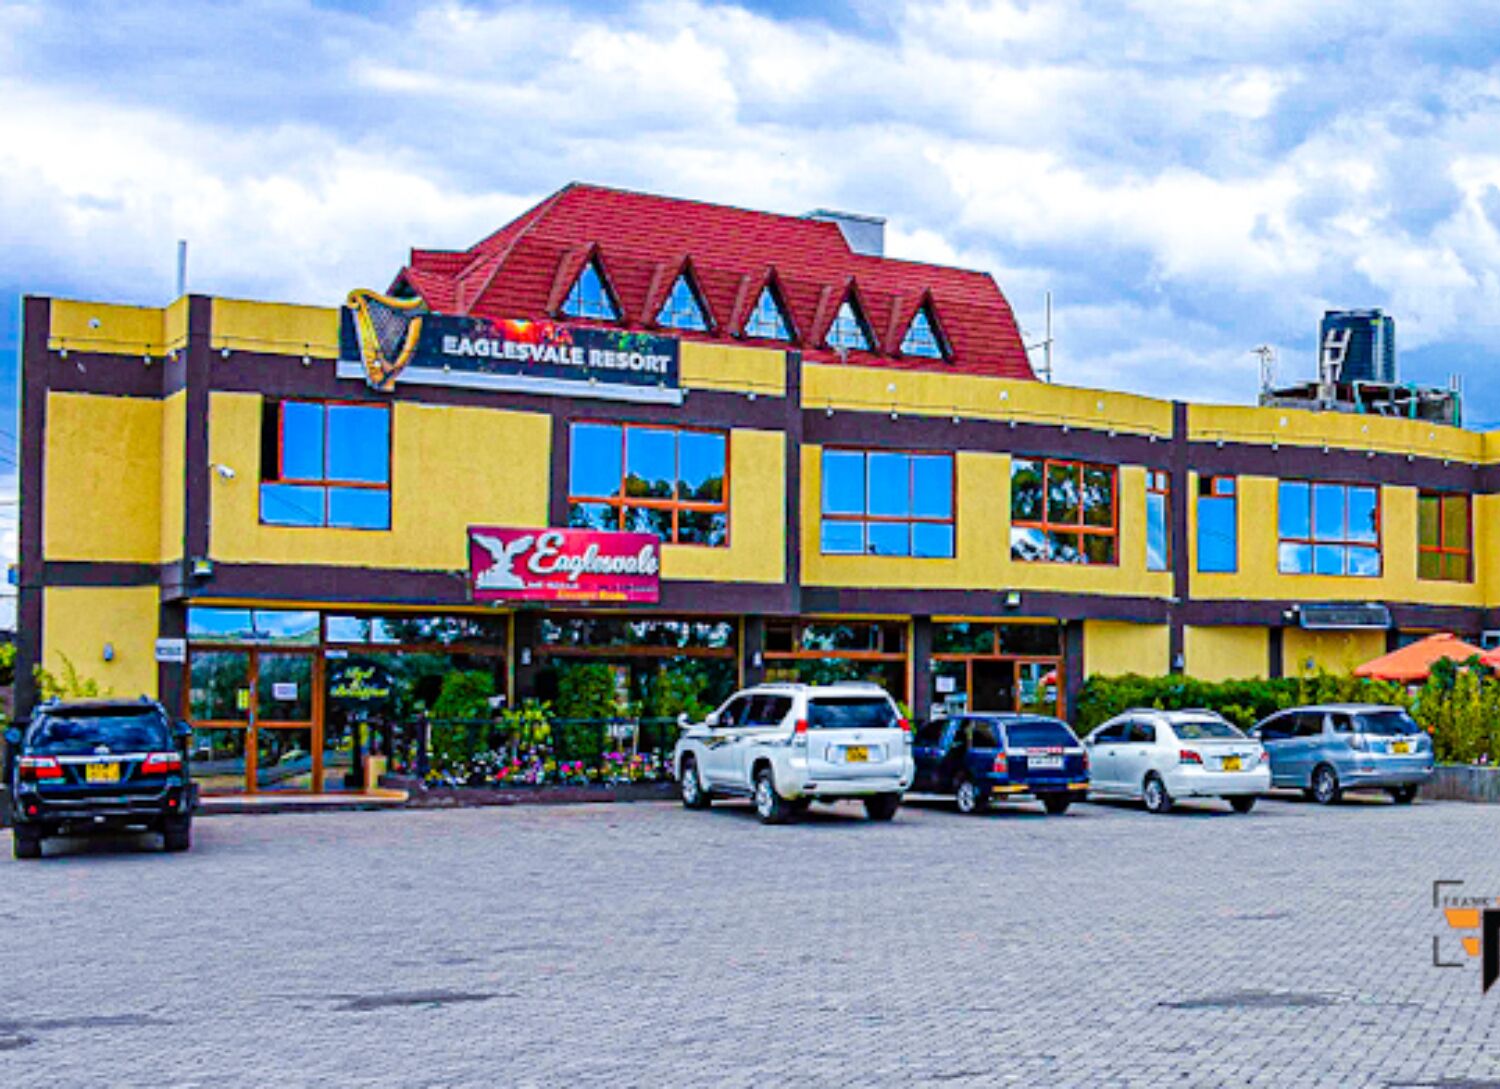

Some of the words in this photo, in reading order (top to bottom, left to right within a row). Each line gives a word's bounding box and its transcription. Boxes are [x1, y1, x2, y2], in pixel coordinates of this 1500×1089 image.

[443, 335, 584, 366] EAGLESVALE
[588, 349, 672, 374] RESORT
[527, 530, 659, 582] Eaglesvale
